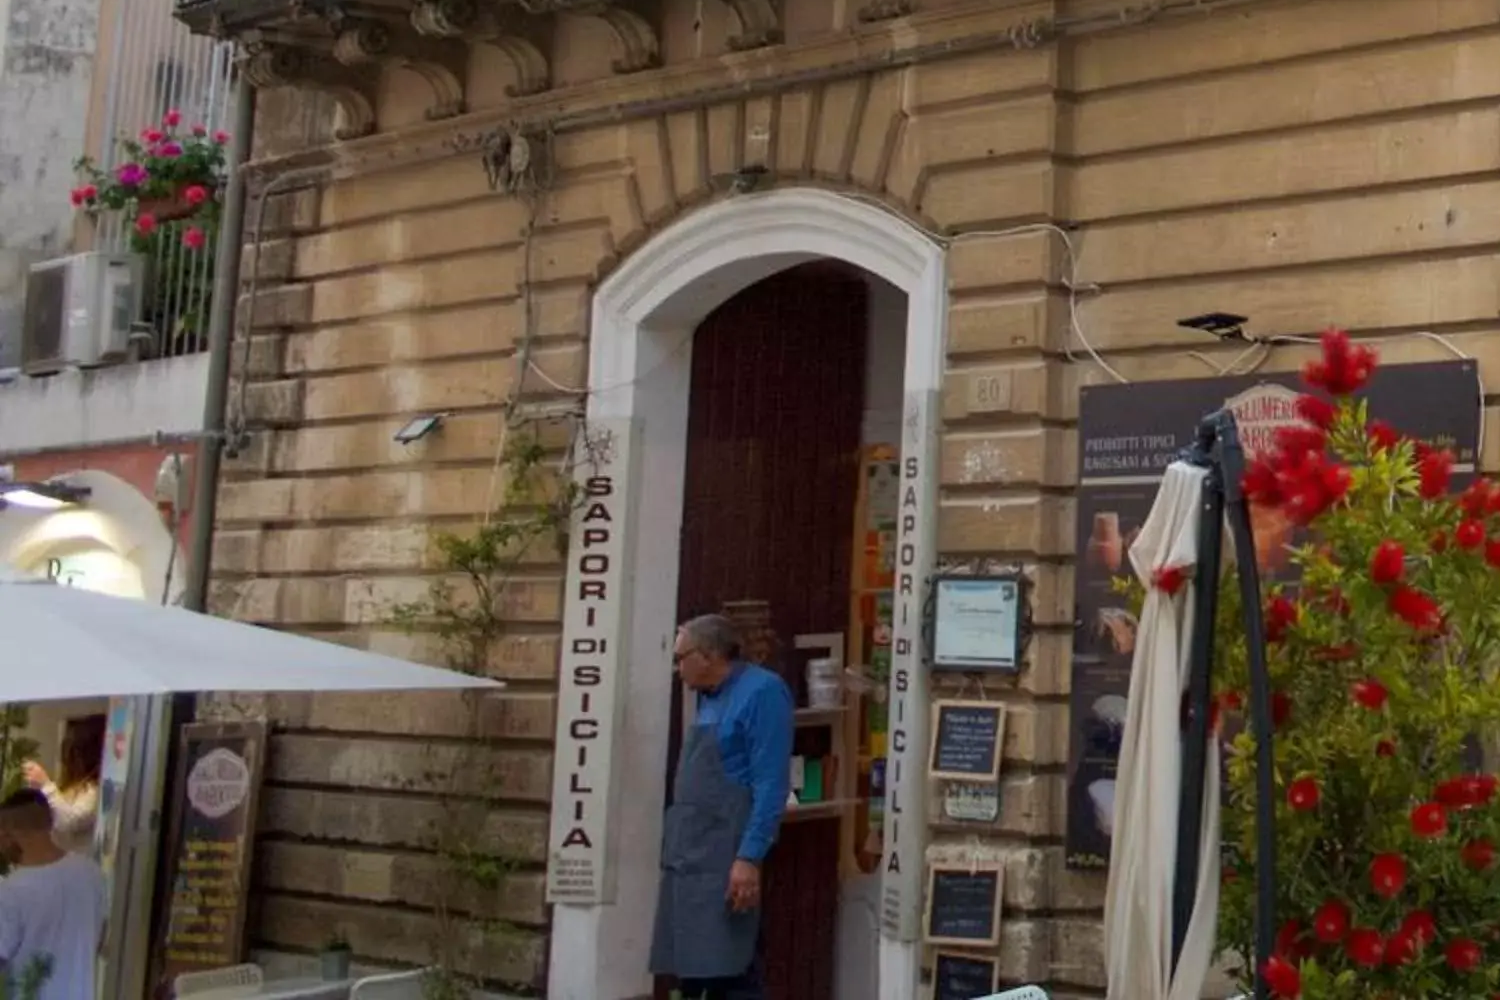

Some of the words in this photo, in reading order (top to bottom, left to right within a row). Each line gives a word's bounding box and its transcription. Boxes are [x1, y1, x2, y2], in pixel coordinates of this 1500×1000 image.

[1142, 433, 1175, 449] TIPICI
[579, 476, 613, 627] SAPORI
[900, 456, 918, 626] SAPORI
[572, 638, 606, 654] DI
[896, 638, 911, 656] DI
[561, 665, 601, 849] SICILIA
[887, 669, 909, 873] SICILIA
